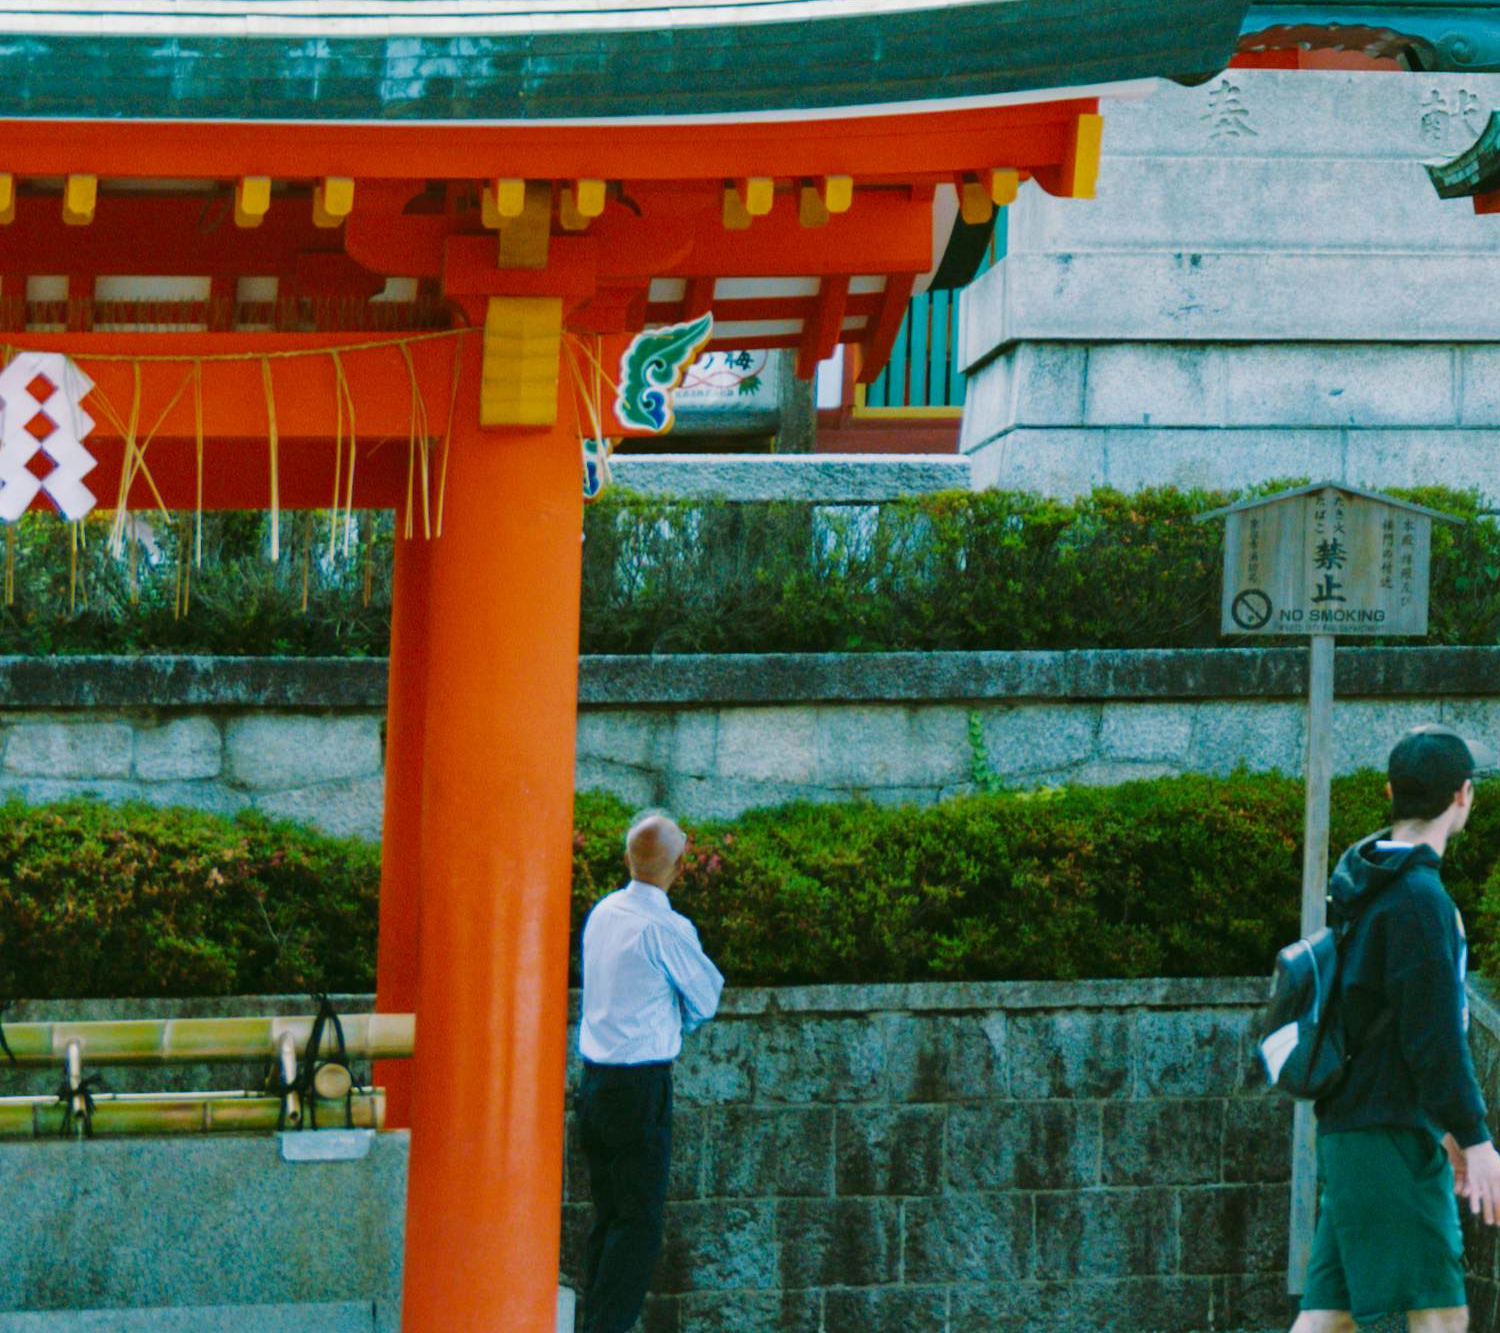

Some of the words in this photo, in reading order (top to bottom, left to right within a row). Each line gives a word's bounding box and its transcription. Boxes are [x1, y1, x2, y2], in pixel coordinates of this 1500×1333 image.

[1310, 537, 1348, 604] 禁止
[1279, 609, 1304, 622] NO
[1308, 609, 1386, 623] SMOKING
